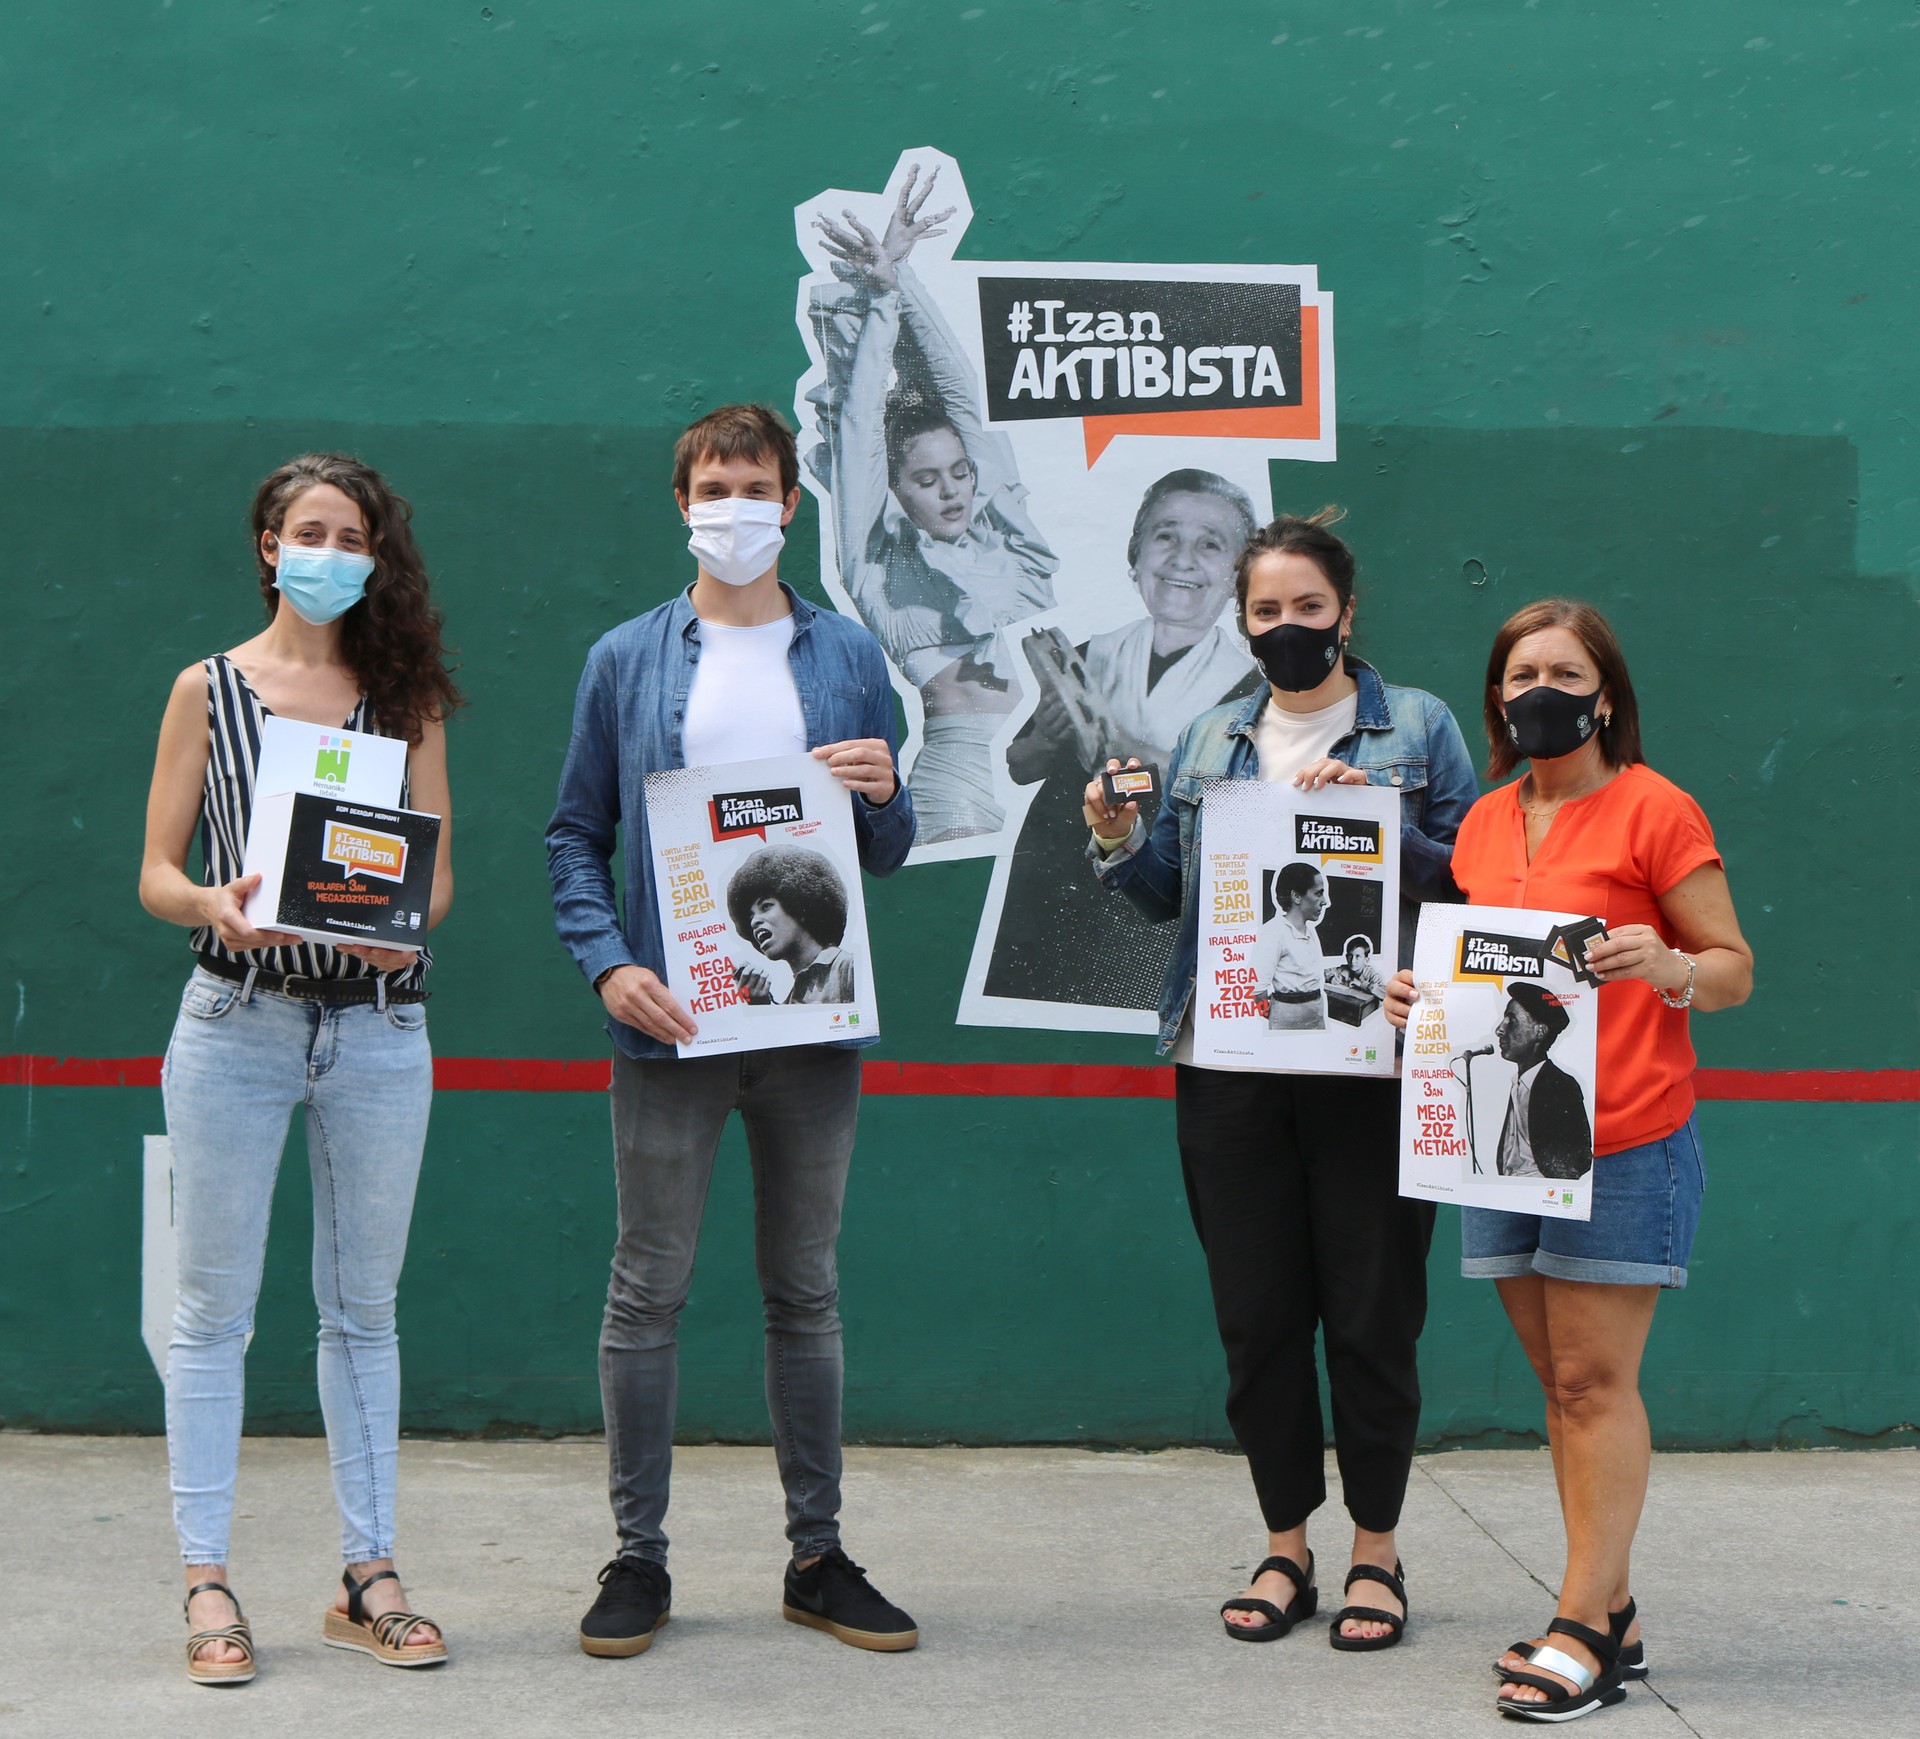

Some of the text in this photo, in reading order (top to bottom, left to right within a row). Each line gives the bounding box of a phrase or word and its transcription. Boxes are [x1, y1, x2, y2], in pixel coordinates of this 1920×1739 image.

[1007, 300, 1164, 343] #Izan
[1008, 346, 1286, 400] AKTIBISTA
[313, 781, 345, 792] Hernaniko
[721, 798, 764, 812] #Izan
[724, 804, 799, 827] AKTIBISTA
[1302, 821, 1344, 834] #Izan
[335, 832, 370, 848] #Izan
[1300, 834, 1375, 852] AKTIBISTA
[333, 844, 394, 865] AKTIBISTA
[661, 843, 701, 856] LORTU ZURE
[667, 852, 698, 863] TXARTELA
[683, 860, 699, 868] JASO
[308, 879, 366, 892] IRAILAREN 3AN
[668, 869, 704, 888] 1.500
[1213, 879, 1248, 893] 1.500
[316, 893, 389, 906] MEGAZOZKETAK!
[672, 882, 709, 906] SARI
[1214, 893, 1250, 910] SARI
[673, 900, 716, 919] ZUZEN
[1212, 910, 1254, 924] ZUZEN
[326, 918, 376, 931] #IzanAktibista
[678, 923, 726, 942] IRAILAREN
[1209, 934, 1256, 946] IRAILAREN
[1468, 938, 1508, 954] #Izan
[694, 941, 718, 956] 3AN
[1222, 947, 1244, 962] 3AN
[690, 956, 736, 980] MEGA
[1464, 952, 1540, 975] AKTIBISTA
[698, 974, 734, 994] ZOZ
[1215, 967, 1258, 986] MEGA
[690, 986, 751, 1014] KETAK!
[1220, 985, 1256, 1001] ZOZ
[1210, 998, 1270, 1020] KETAK!
[1420, 1008, 1444, 1021] 1.500
[1416, 1024, 1446, 1040] SARI
[696, 1036, 738, 1045] #IzanAktibista
[1414, 1042, 1450, 1054] ZUZEN
[1412, 1069, 1454, 1078] IRAILAREN
[1424, 1082, 1443, 1097] 3AN
[1417, 1104, 1456, 1121] MEGA
[1422, 1122, 1454, 1138] ZOZ
[1413, 1139, 1467, 1156] KETAK!
